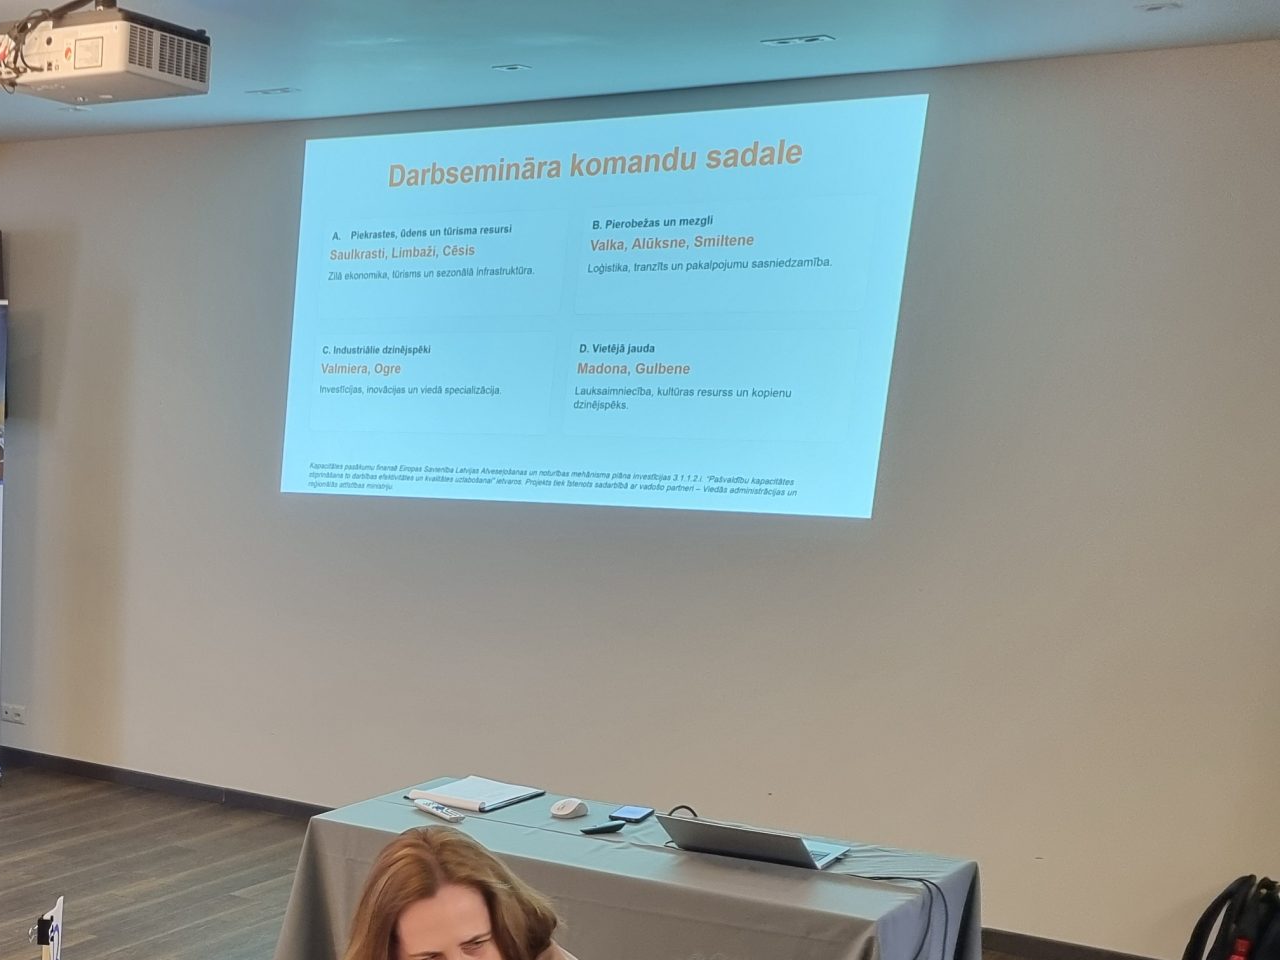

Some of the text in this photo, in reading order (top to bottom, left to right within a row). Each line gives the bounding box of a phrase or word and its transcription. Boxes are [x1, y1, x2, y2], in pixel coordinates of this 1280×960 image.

[387, 140, 802, 186] Darbsemināra komandu sadale
[592, 215, 713, 229] B. Pierobežas un mezgli
[332, 231, 340, 240] A.
[350, 230, 397, 239] Piekrastes,
[400, 228, 427, 237] ūdens
[443, 226, 477, 235] tūrisma
[479, 224, 512, 234] resursi
[590, 234, 754, 251] Valka, Alūksne, Smiltene
[329, 244, 475, 260] Saulkrasti, Limbaži, Cēsis
[587, 257, 832, 274] Loģistika, tranzīts un pakalpojumu sasniedzamība.
[327, 266, 534, 280] Zilā ekonomika, tūrisms un sezonālā infrastruktūra.
[322, 345, 431, 355] C. Industriālie dzinējspēki
[579, 343, 655, 354] D. Vietējā jauda
[321, 363, 401, 376] Valmiera, Ogre
[577, 362, 690, 375] Madona, Gulbene
[319, 384, 501, 396] Investīcijas, inovācijas un viedā specializācija.
[574, 386, 653, 396] Lauksaimniecība,
[656, 386, 694, 396] kultūras
[736, 389, 748, 397] un
[751, 387, 792, 399] kopienu
[573, 400, 628, 410] dzinējspēks.
